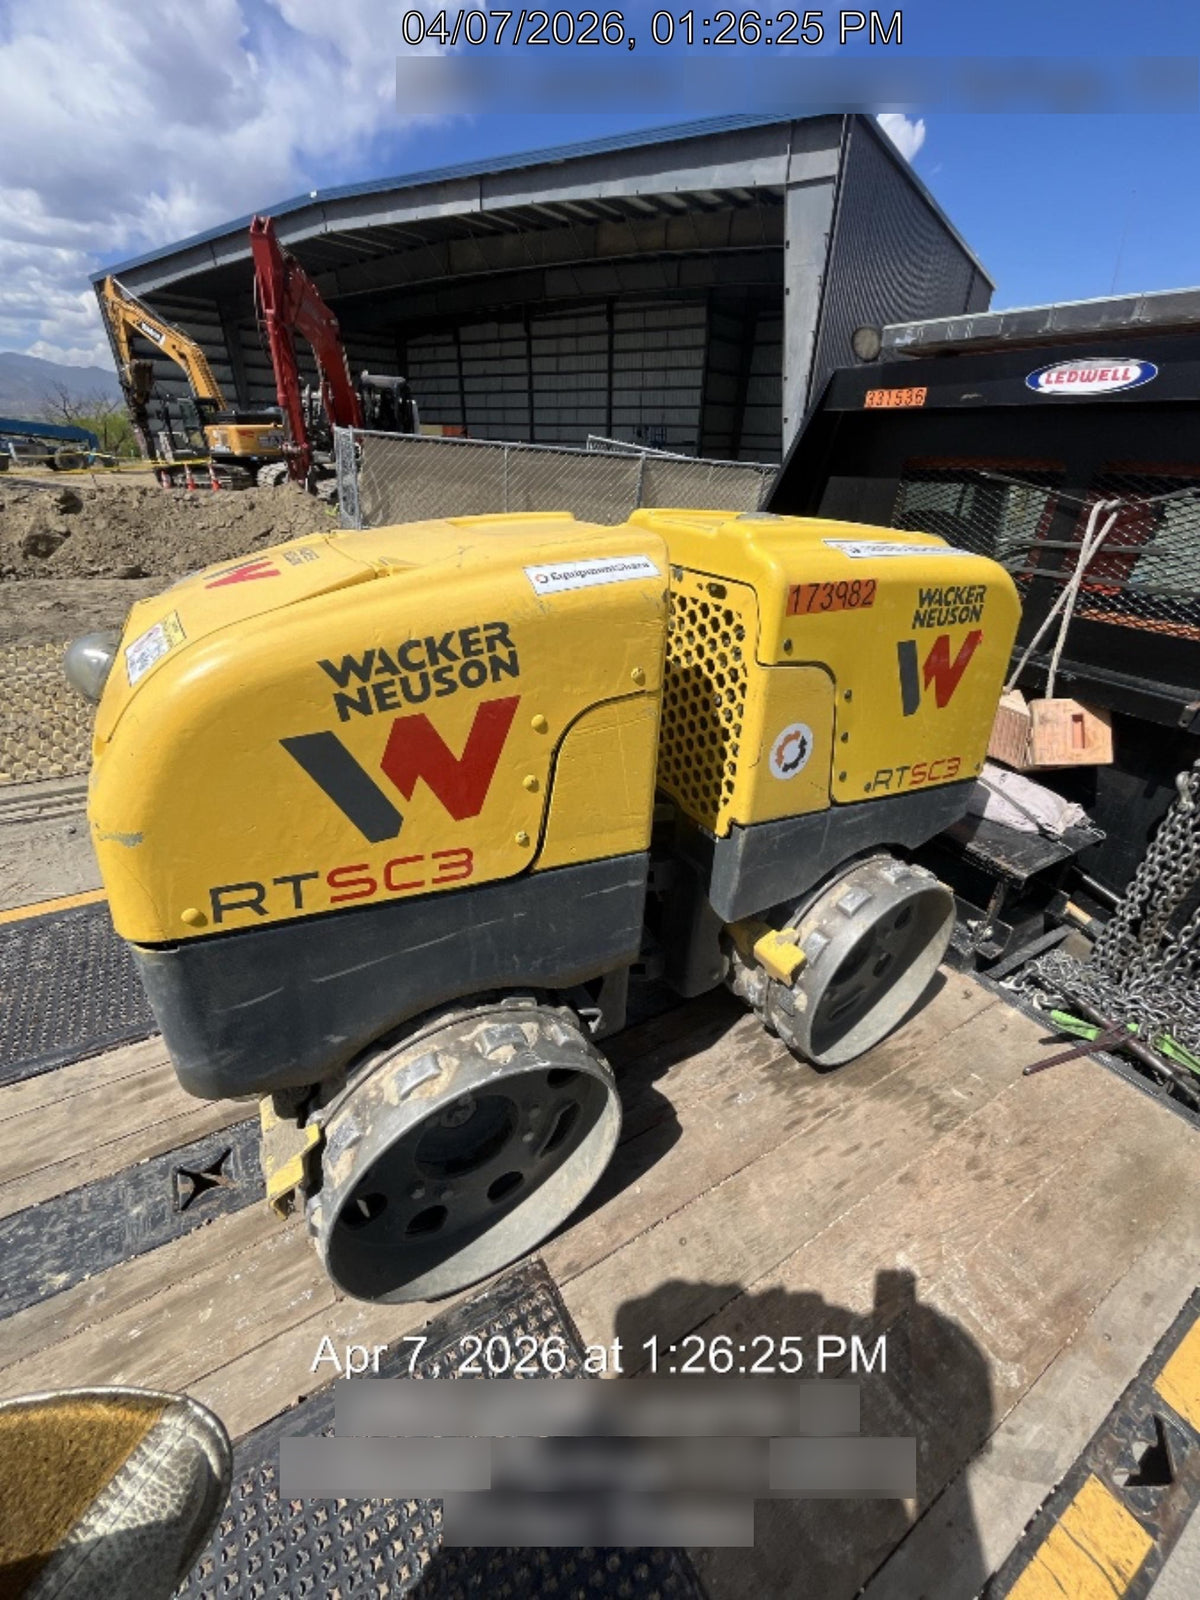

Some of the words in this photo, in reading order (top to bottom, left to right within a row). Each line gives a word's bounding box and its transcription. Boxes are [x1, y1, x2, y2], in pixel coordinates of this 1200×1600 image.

[1044, 366, 1132, 385] LEDWELL
[791, 579, 876, 613] 173982
[918, 584, 988, 609] WACKER
[911, 605, 984, 630] NEUSON
[316, 621, 516, 688] WACKER
[332, 650, 520, 722] NEUSON
[872, 756, 961, 792] RTSC3
[209, 847, 474, 924] RTSC3
